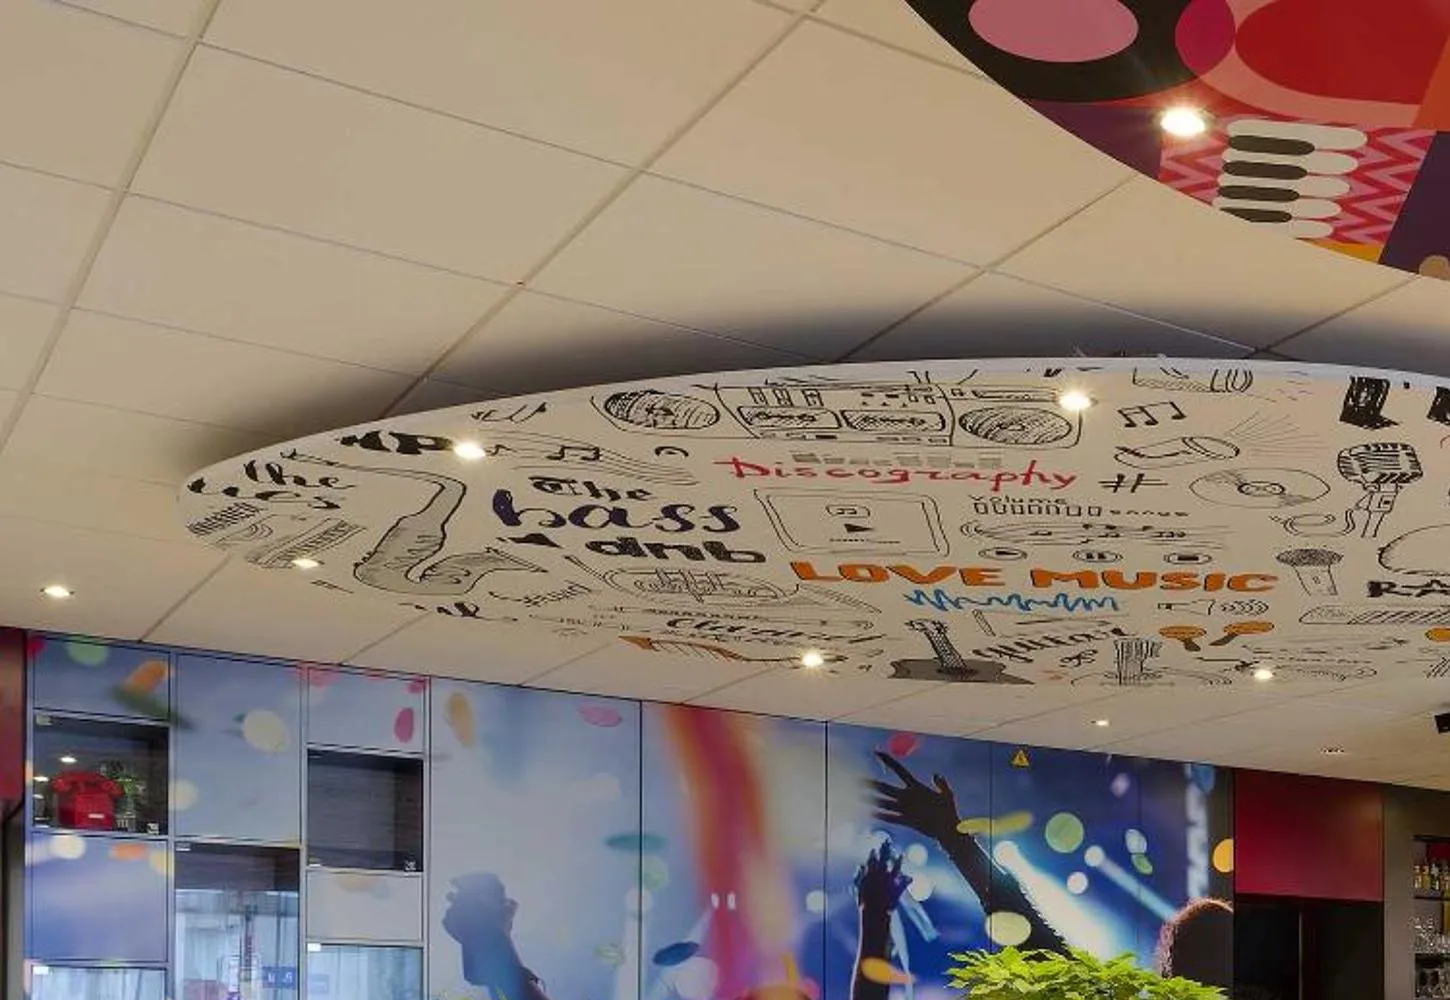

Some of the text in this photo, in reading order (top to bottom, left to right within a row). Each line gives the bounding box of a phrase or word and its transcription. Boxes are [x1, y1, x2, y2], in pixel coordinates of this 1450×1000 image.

[712, 457, 1078, 492] Discography
[492, 489, 741, 534] bass
[789, 561, 1279, 592] LOVE MUSIC
